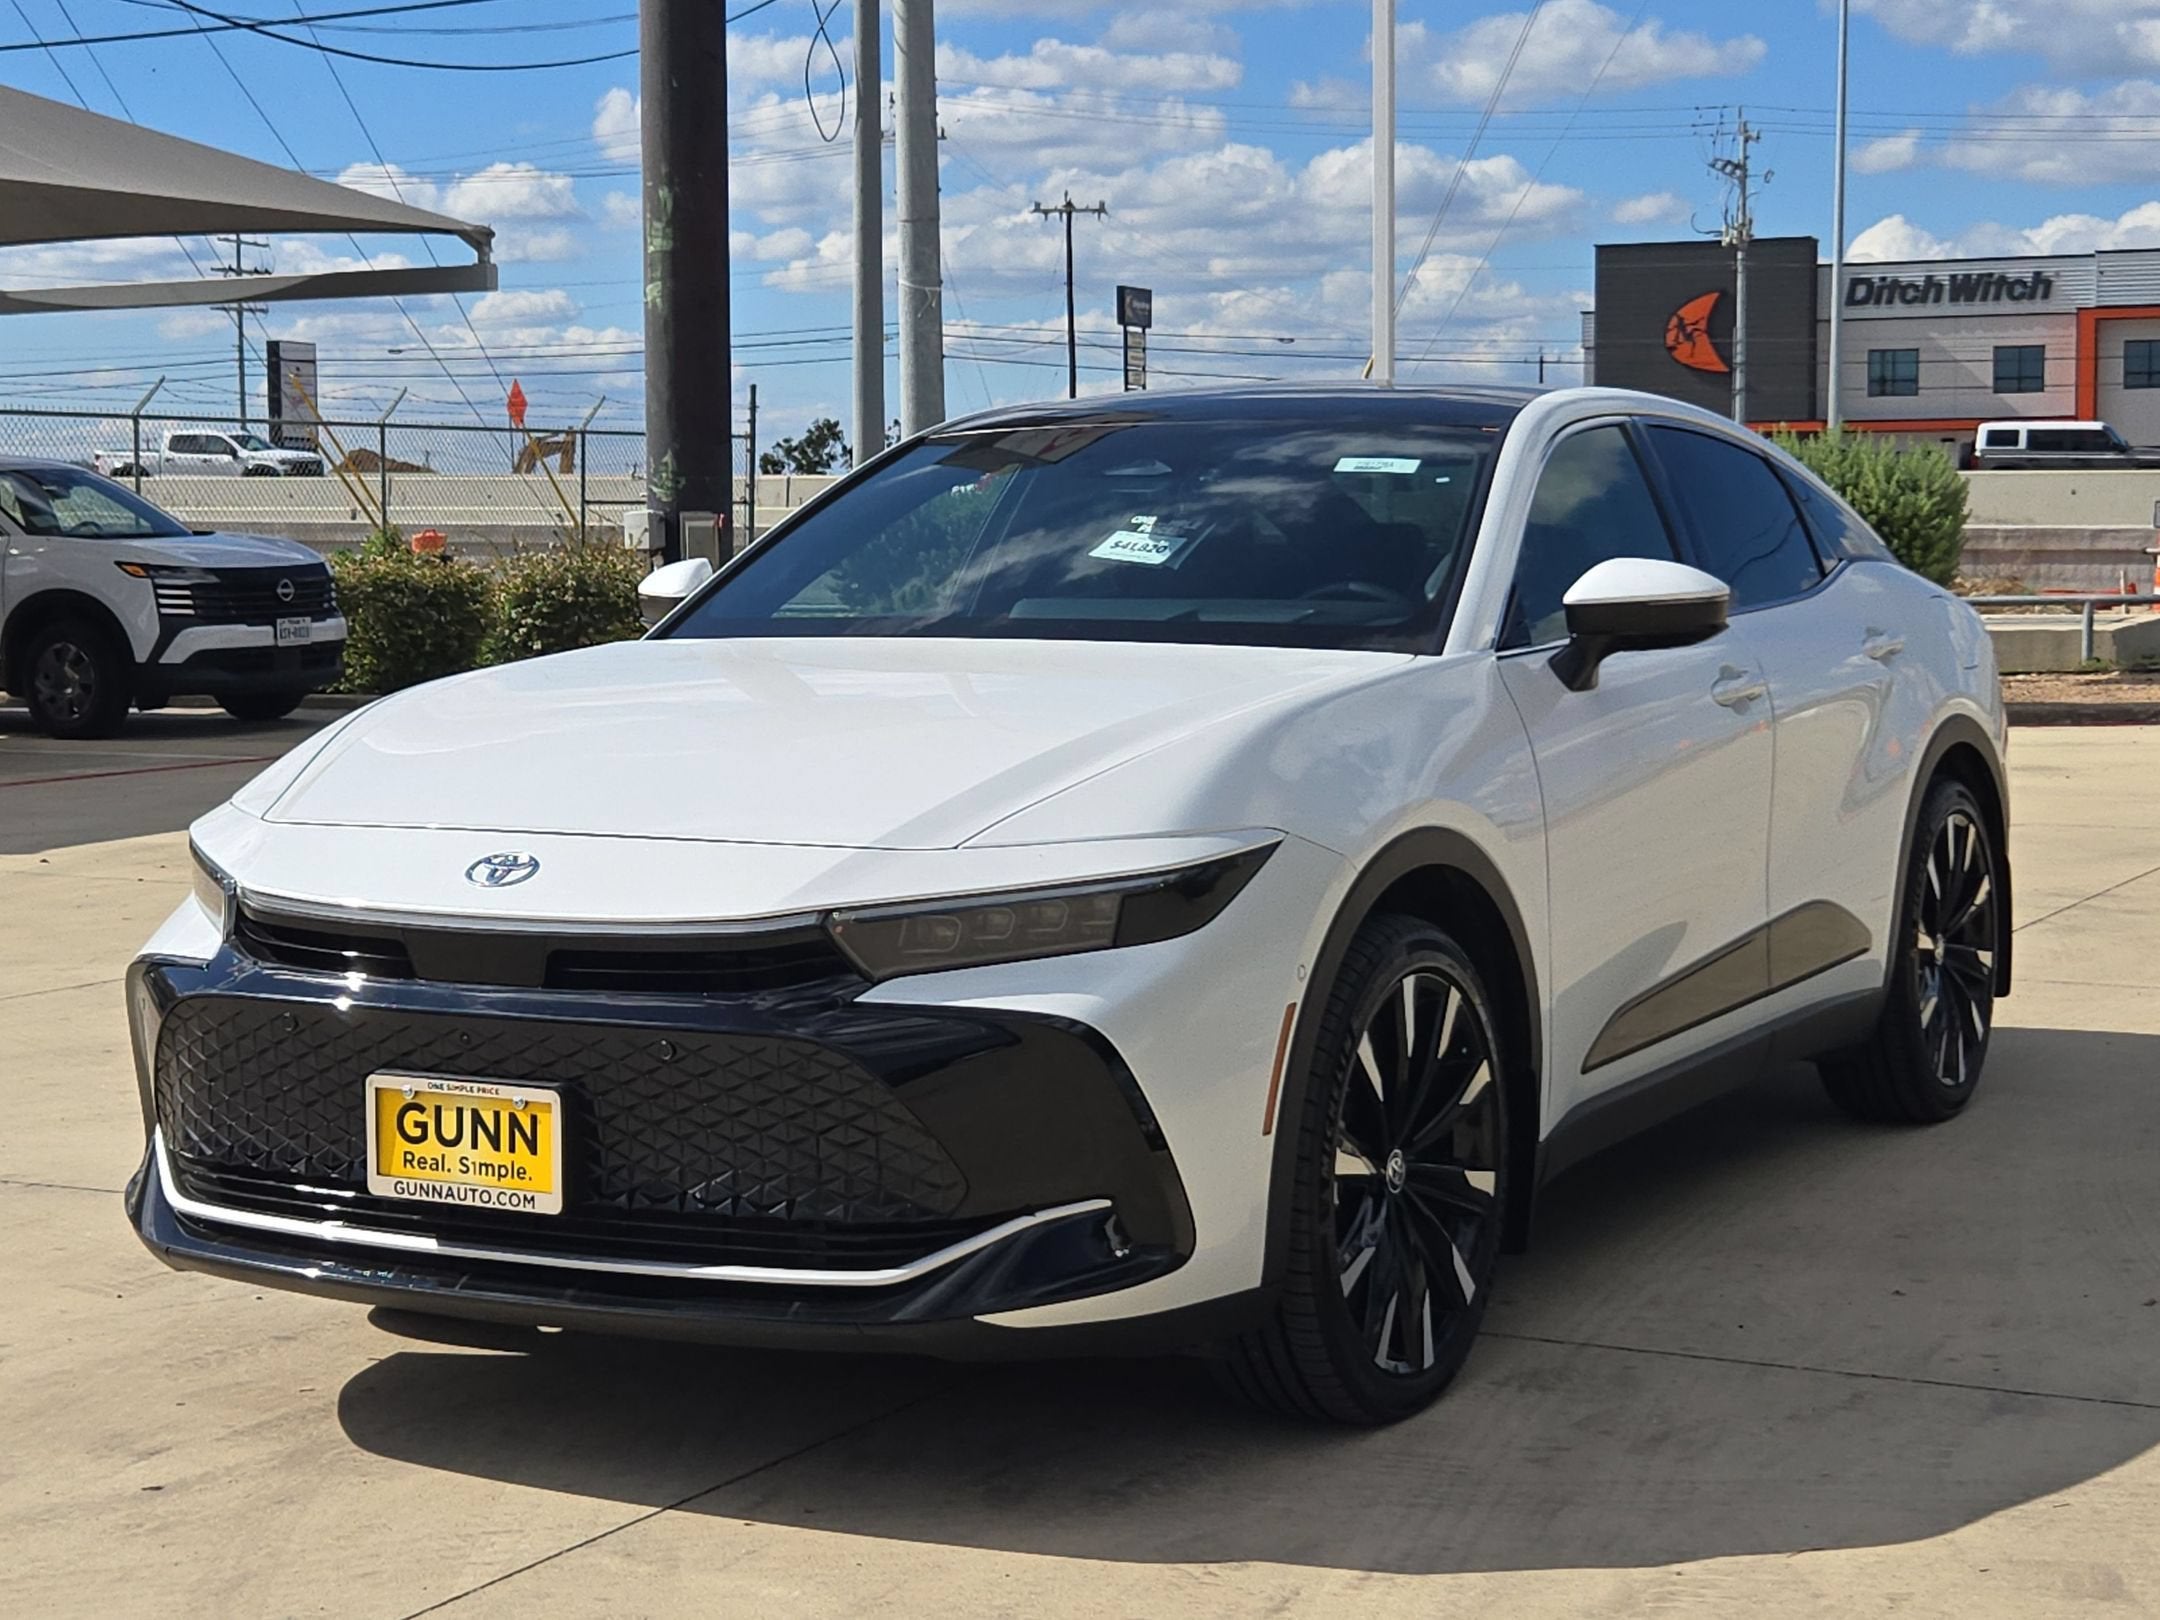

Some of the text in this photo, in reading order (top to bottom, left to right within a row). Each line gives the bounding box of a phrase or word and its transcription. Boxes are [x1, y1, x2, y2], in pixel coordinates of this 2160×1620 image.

[1845, 271, 2054, 307] Ditch Witch
[427, 1081, 500, 1095] ONE SIMPLE PRICE
[396, 1102, 538, 1156] GUNN
[403, 1150, 451, 1173] Real.
[394, 1180, 536, 1210] GUNNAUTO.COM
